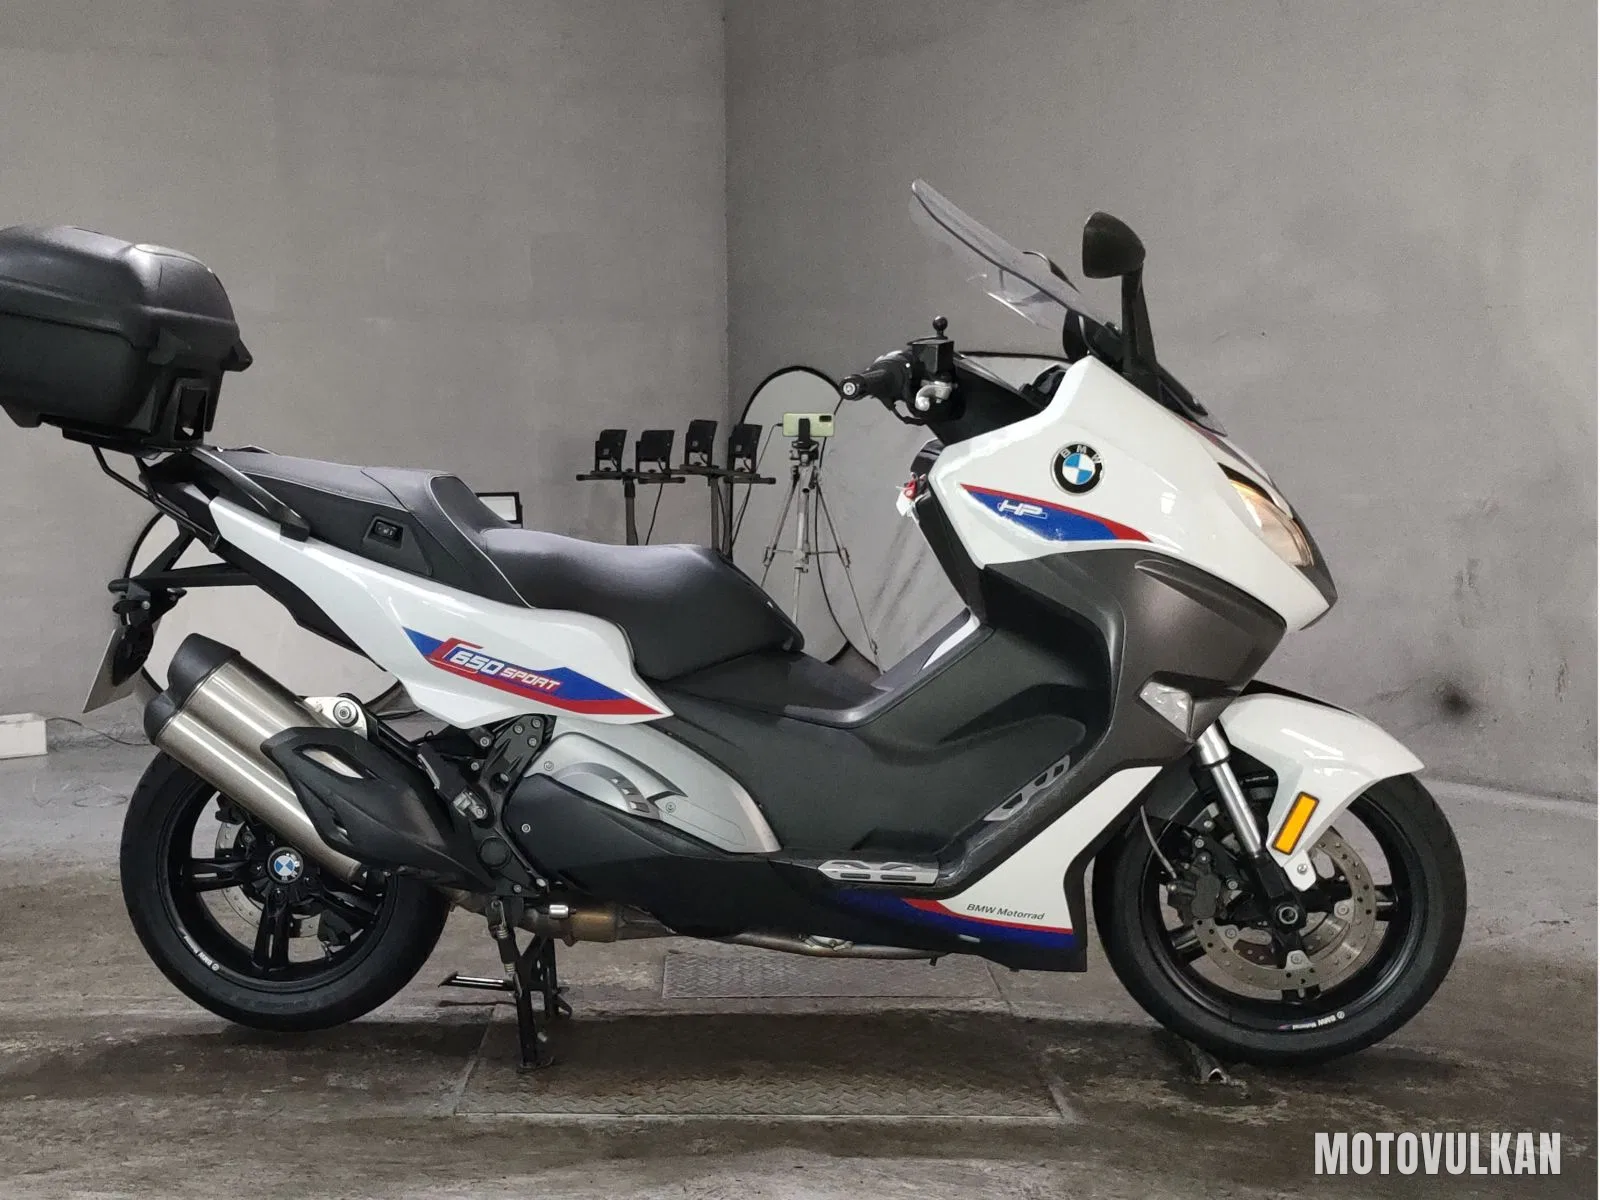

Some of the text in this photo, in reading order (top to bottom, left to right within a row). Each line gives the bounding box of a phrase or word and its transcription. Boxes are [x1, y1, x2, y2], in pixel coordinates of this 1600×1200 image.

[1060, 444, 1101, 464] BMW
[998, 499, 1044, 517] HP
[500, 667, 560, 690] SPORT
[967, 903, 1045, 920] BMW Motorrad
